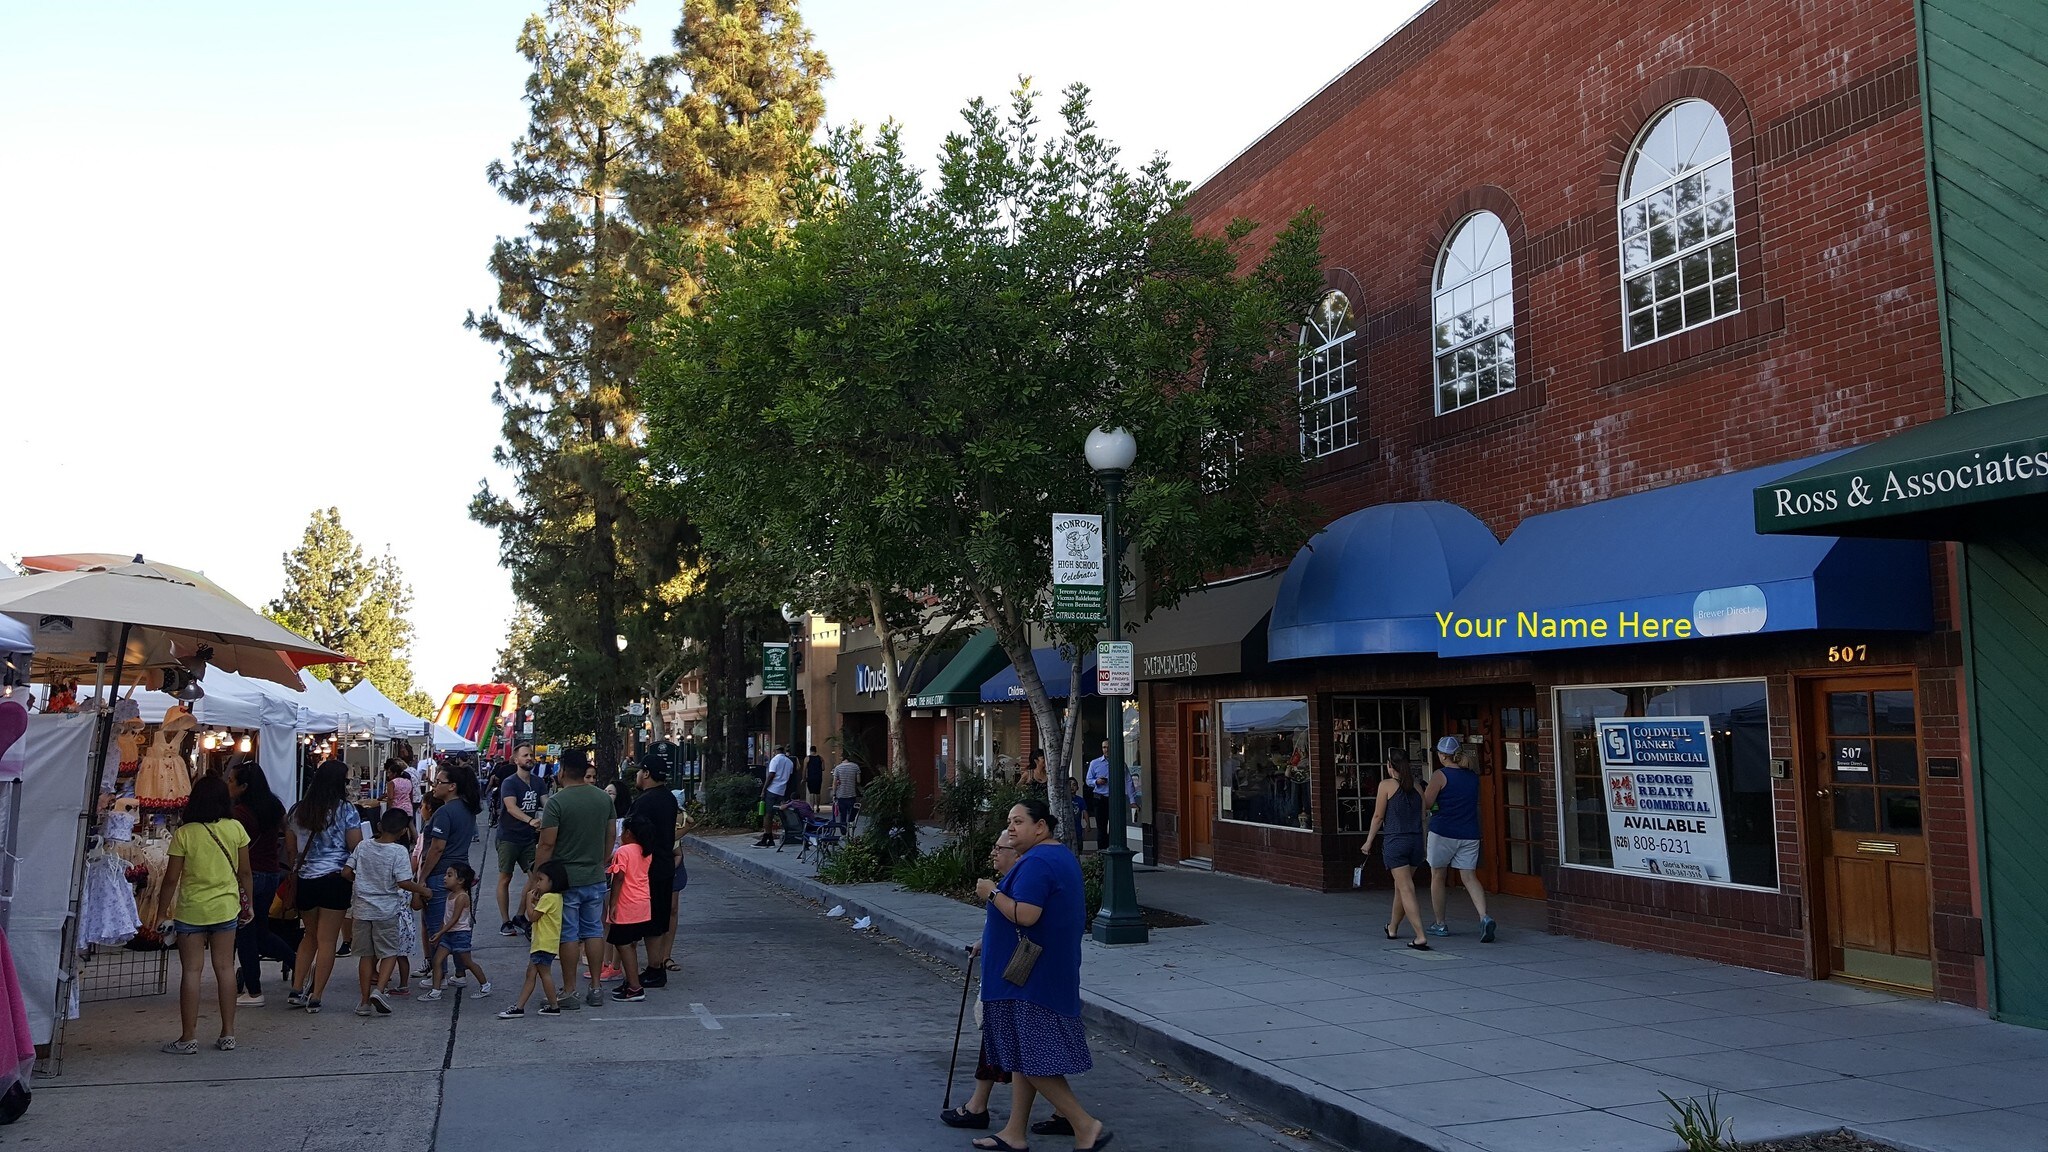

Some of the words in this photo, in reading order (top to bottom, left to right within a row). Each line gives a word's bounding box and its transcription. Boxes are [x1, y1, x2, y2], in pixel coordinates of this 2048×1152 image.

[1774, 487, 1838, 517] Ross
[1847, 476, 1873, 507] &
[1881, 450, 2048, 502] Associates
[1056, 519, 1100, 535] MONROVIA
[1058, 560, 1074, 569] HIGH
[1075, 560, 1100, 570] SCHOOL
[1061, 570, 1097, 584] Celebrates
[1055, 611, 1075, 619] CITRUS
[1076, 611, 1101, 620] COLLEGE
[1698, 609, 1724, 619] Brewer
[1727, 606, 1750, 616] Direct
[1099, 644, 1109, 653] 90
[1828, 644, 1867, 662] 507
[1100, 671, 1109, 680] NO
[1632, 726, 1690, 738] COLDWELL
[1634, 739, 1676, 750] BANKER
[1636, 751, 1706, 763] COMMERCIAL
[1841, 747, 1861, 759] 507
[1635, 773, 1693, 785] GEORGE
[1638, 786, 1694, 797] REALTY
[1639, 799, 1711, 812] COMMERCIAL
[1623, 815, 1707, 834] AVAILABLE
[1613, 835, 1631, 851] (626)
[1633, 835, 1692, 855] 808-6231
[1662, 860, 1680, 870] Gloria
